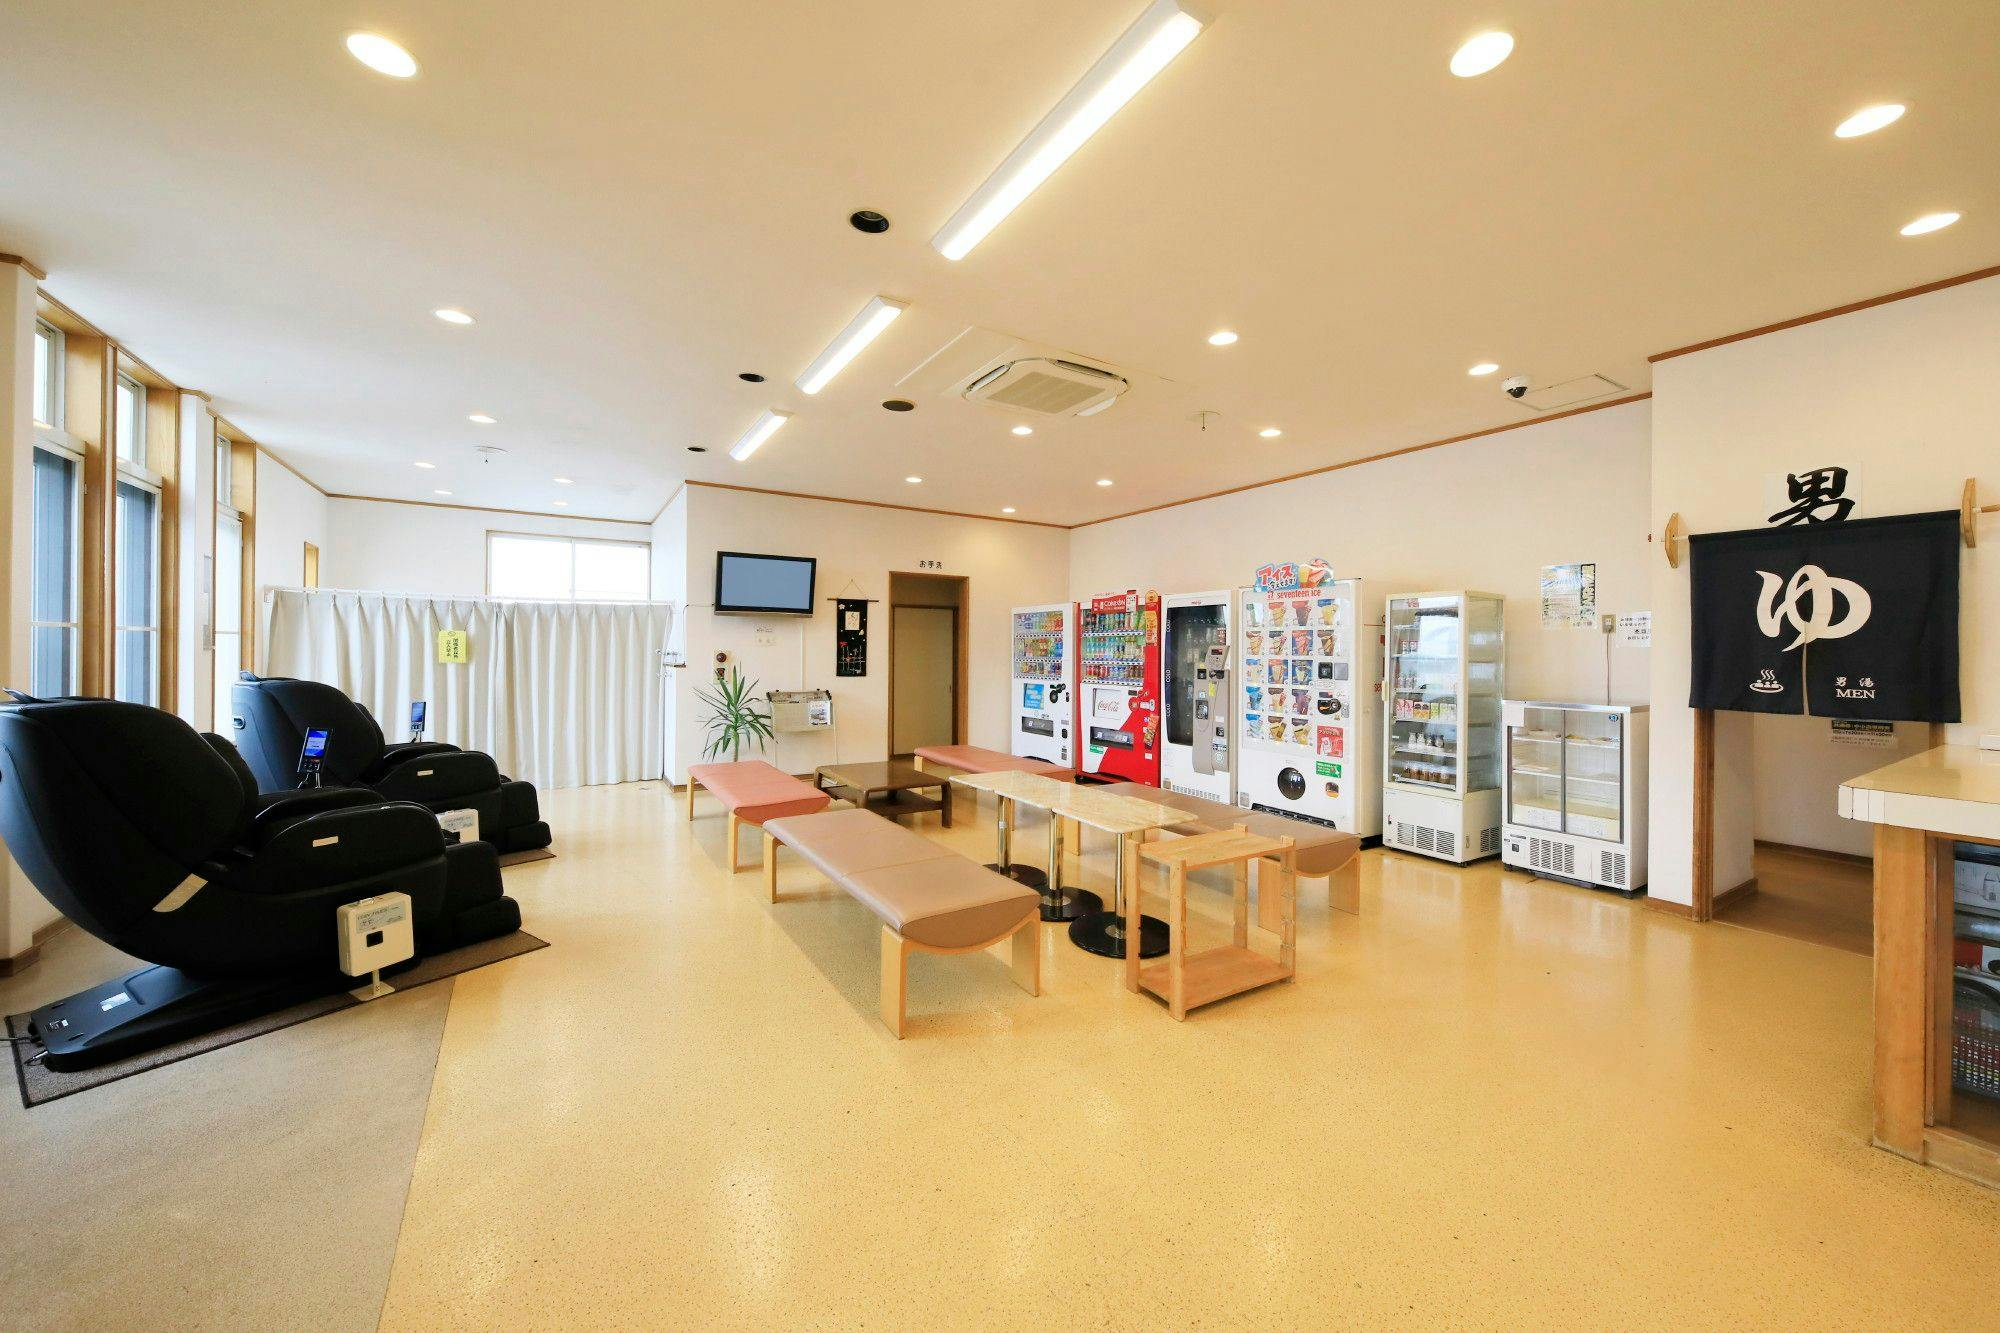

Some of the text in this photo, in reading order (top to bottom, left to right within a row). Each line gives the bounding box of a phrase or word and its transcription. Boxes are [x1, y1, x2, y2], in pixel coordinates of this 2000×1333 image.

[1767, 466, 1856, 527] 男
[1258, 565, 1294, 586] アイス
[1755, 564, 1872, 653] ゆ
[1835, 689, 1876, 699] MEN
